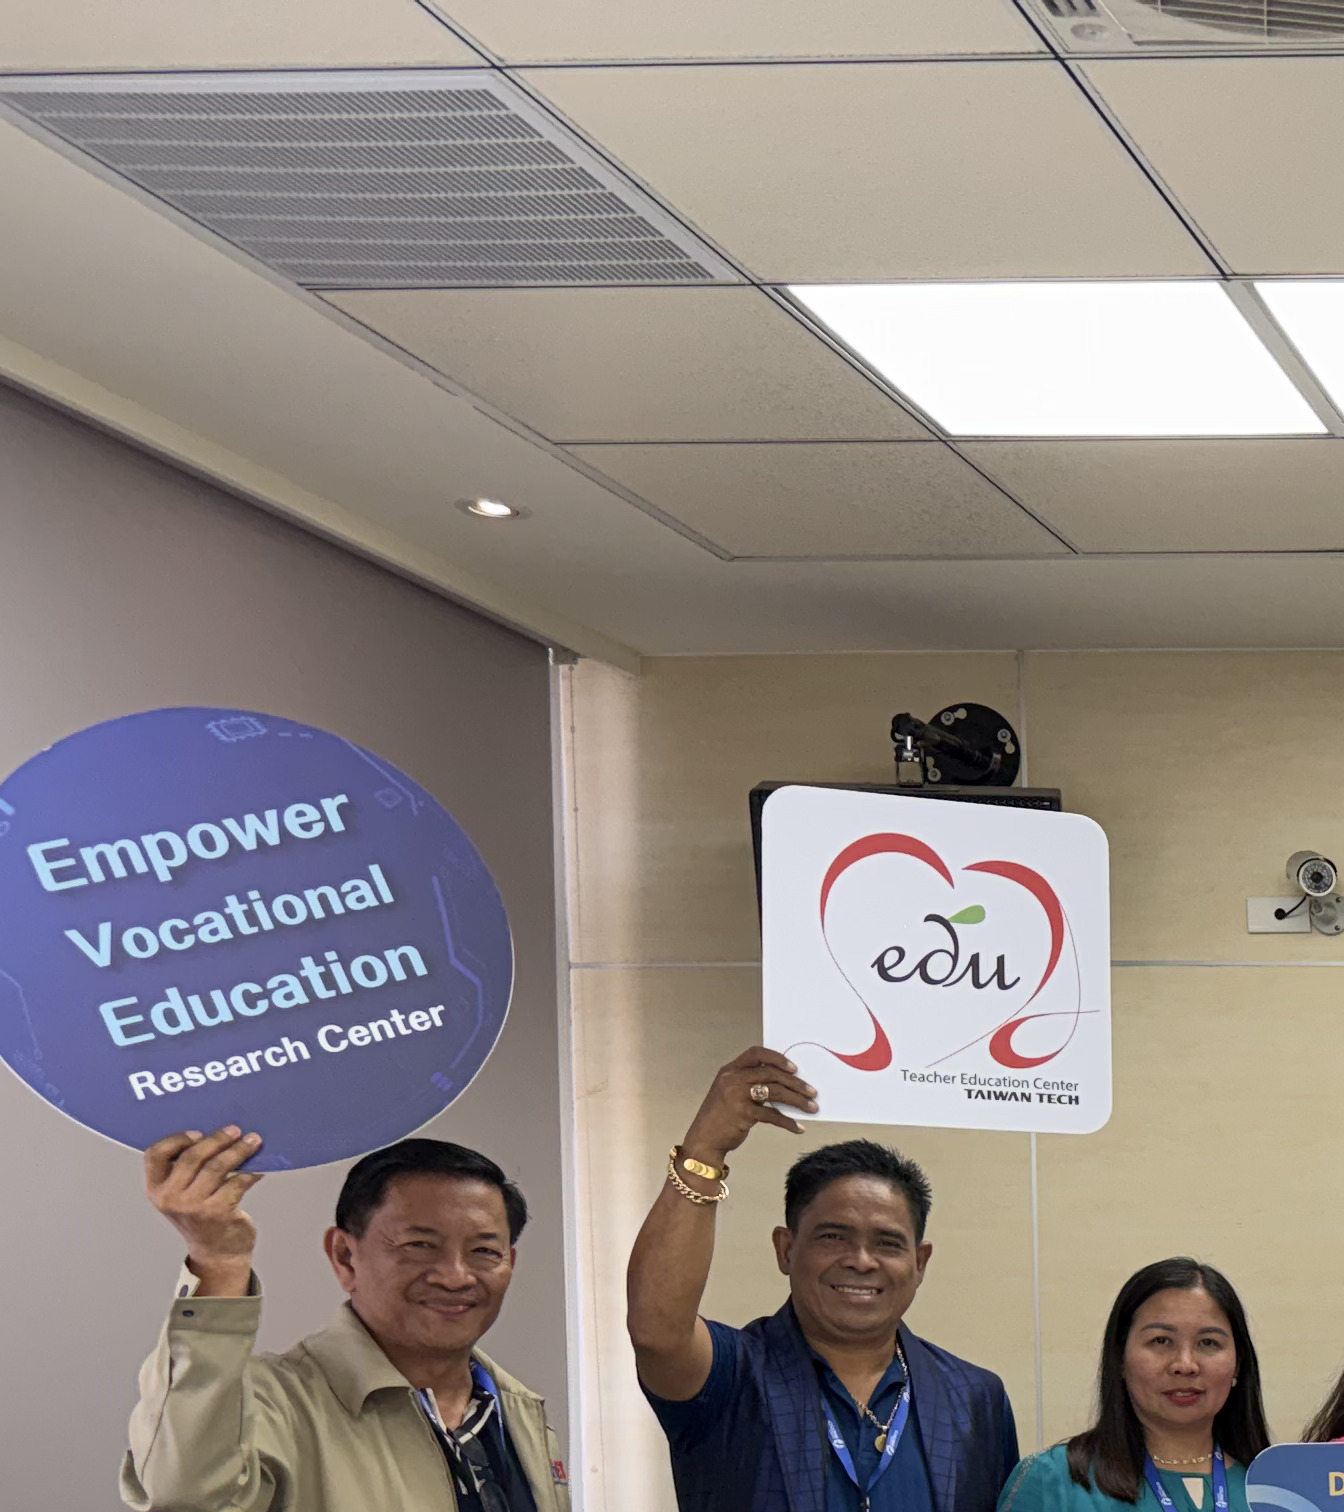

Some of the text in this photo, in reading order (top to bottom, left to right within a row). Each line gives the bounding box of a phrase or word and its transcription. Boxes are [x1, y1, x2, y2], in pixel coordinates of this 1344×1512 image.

[27, 794, 350, 893] Empower
[64, 864, 396, 967] Vocational
[870, 914, 1021, 991] edu
[99, 945, 428, 1047] Education
[128, 1002, 446, 1100] Research Center
[900, 1068, 1079, 1092] Teacher Education Center
[964, 1088, 1080, 1106] TAIWAN TECH
